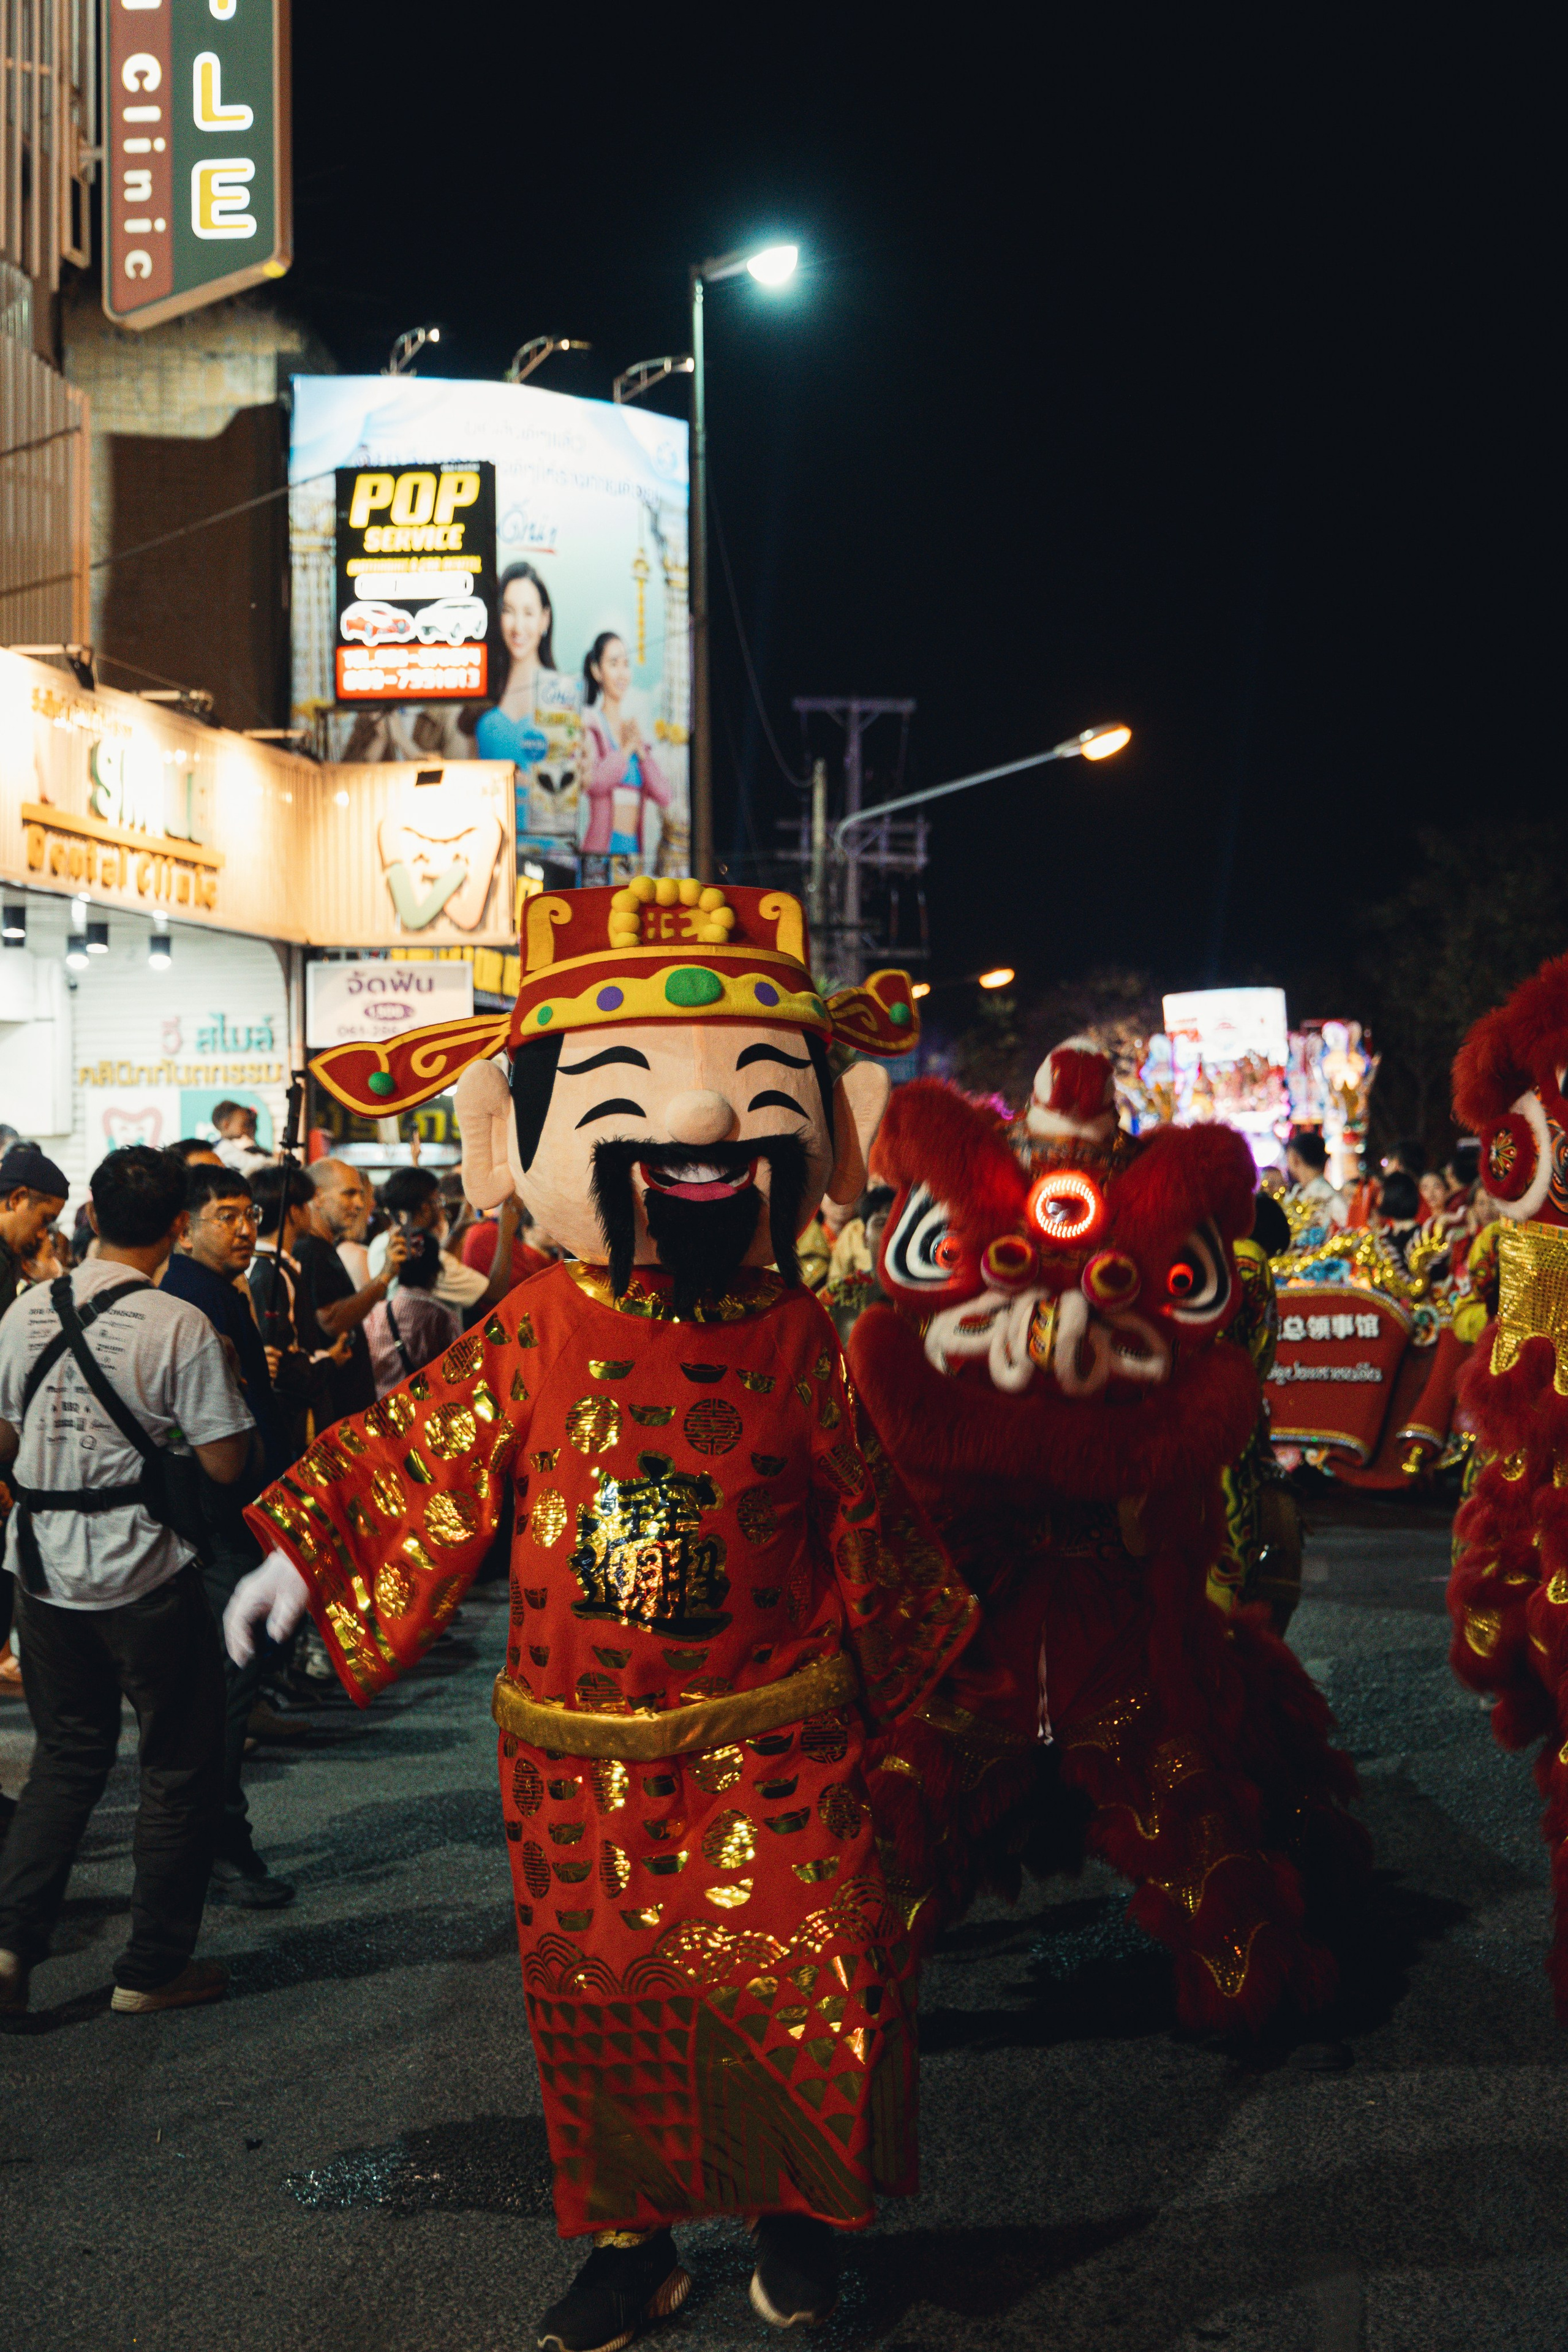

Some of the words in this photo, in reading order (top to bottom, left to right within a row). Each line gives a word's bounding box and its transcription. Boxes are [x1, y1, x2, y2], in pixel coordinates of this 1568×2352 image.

[191, 0, 257, 239] LE
[122, 53, 166, 279] Clinic
[349, 472, 480, 528] POP
[363, 523, 466, 552] SERVICE
[26, 823, 128, 891] Dental
[136, 850, 217, 910] Clinic
[347, 971, 434, 994] จัดฟัน
[1277, 1313, 1379, 1341] 总领事馆
